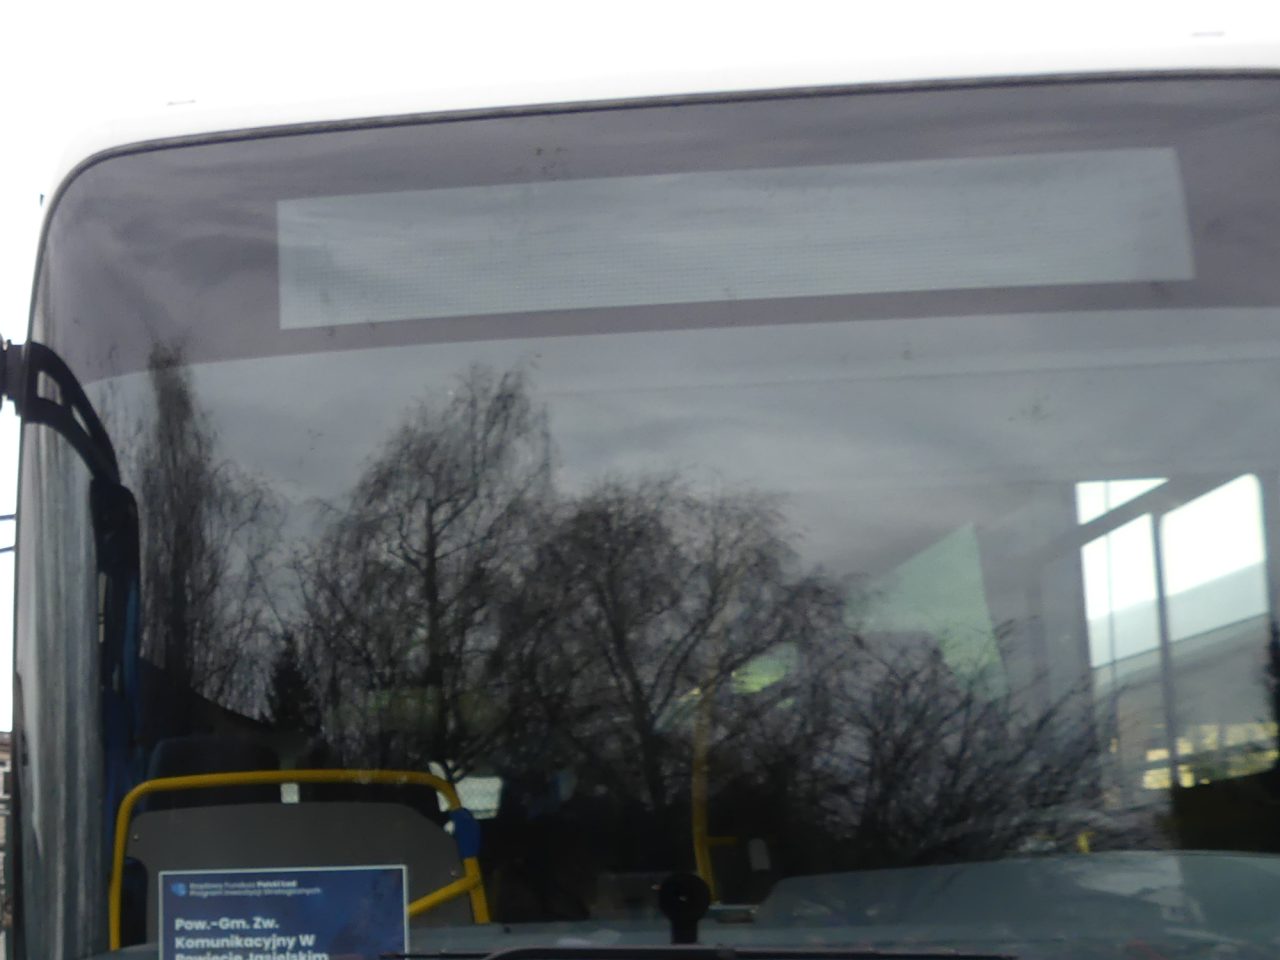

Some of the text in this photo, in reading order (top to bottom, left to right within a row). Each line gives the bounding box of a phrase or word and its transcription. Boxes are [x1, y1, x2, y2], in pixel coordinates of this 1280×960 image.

[253, 916, 280, 929] Zw.
[175, 934, 316, 950] Komunikacyjny W
